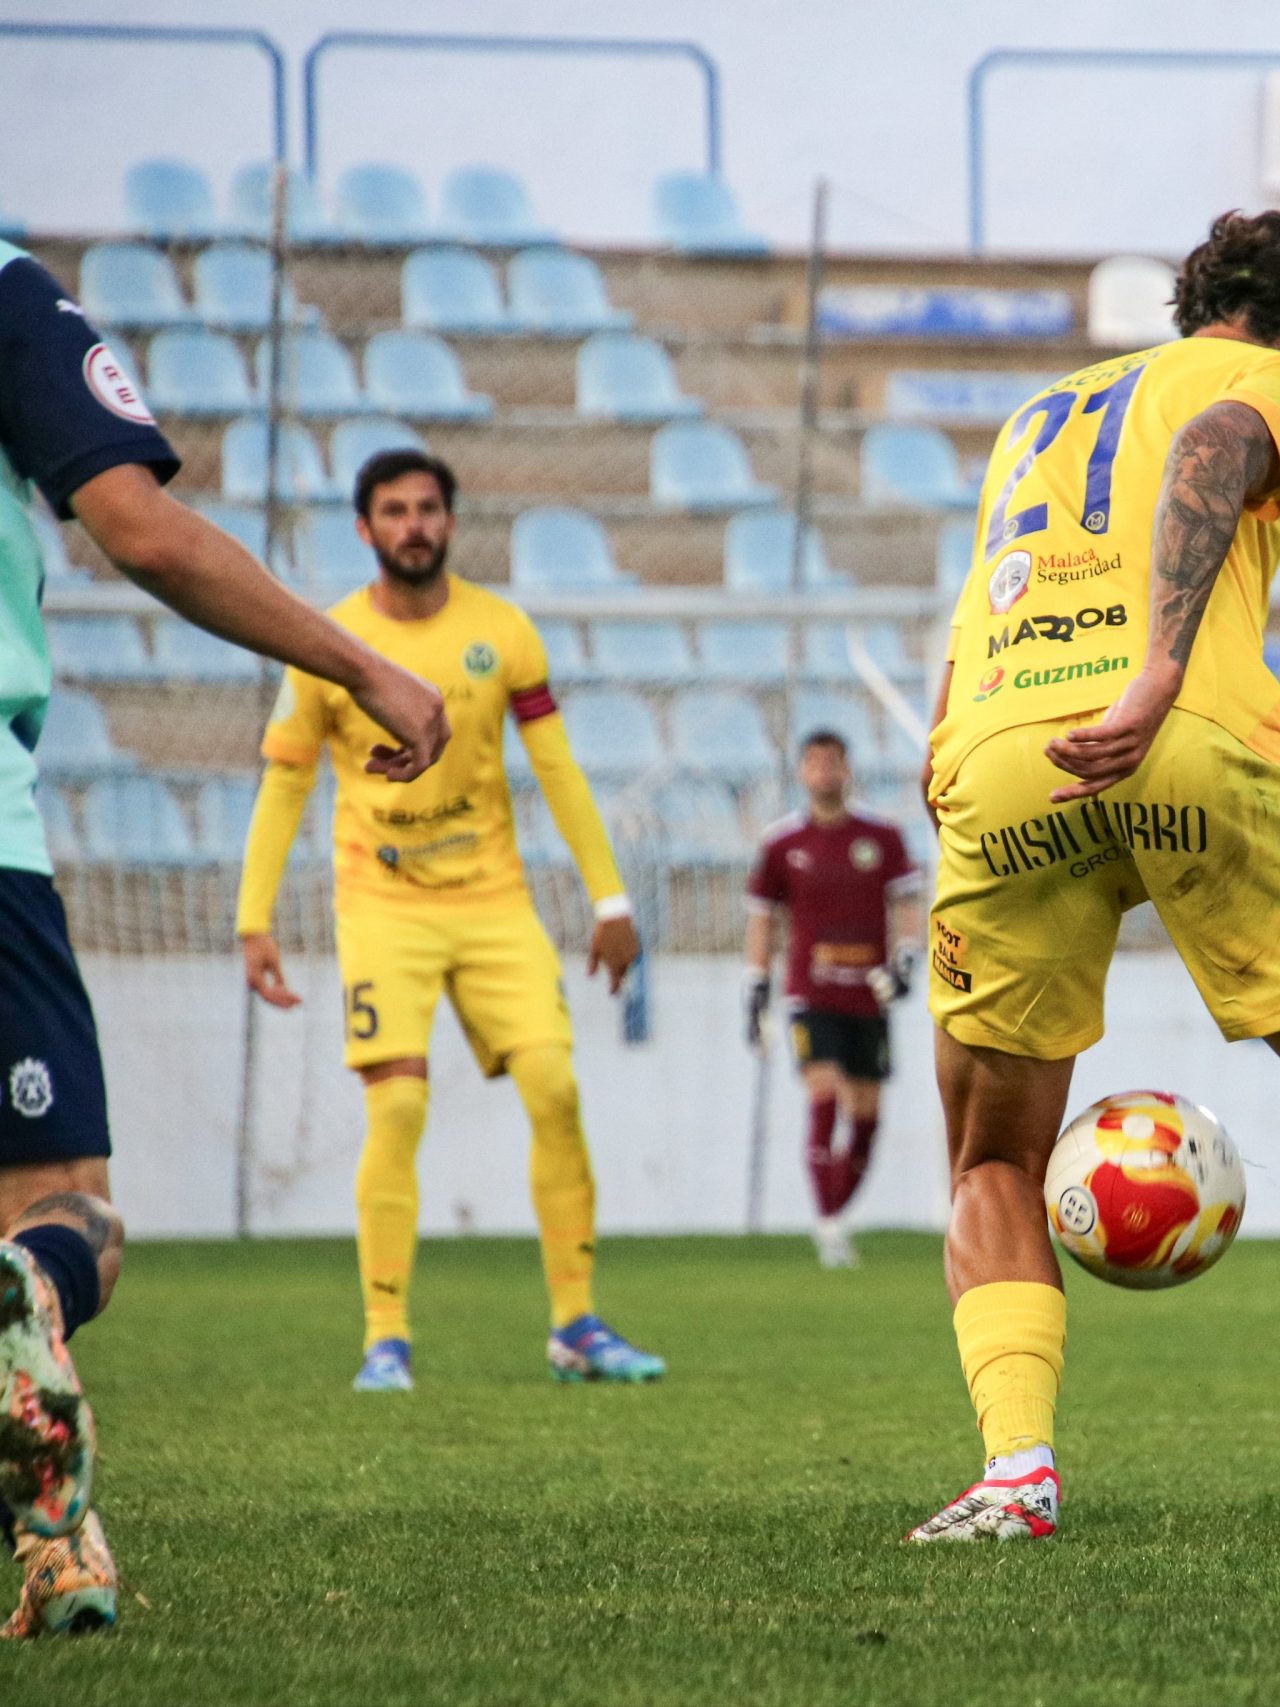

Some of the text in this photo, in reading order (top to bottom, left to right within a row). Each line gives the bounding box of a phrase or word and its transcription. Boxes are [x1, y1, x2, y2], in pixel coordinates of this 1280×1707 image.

[985, 362, 1148, 565] 21
[1037, 548, 1097, 570] Malaca
[1037, 553, 1122, 585] Seguridad
[1013, 655, 1129, 689] Guzmán
[980, 799, 1208, 878] CASA CURRO
